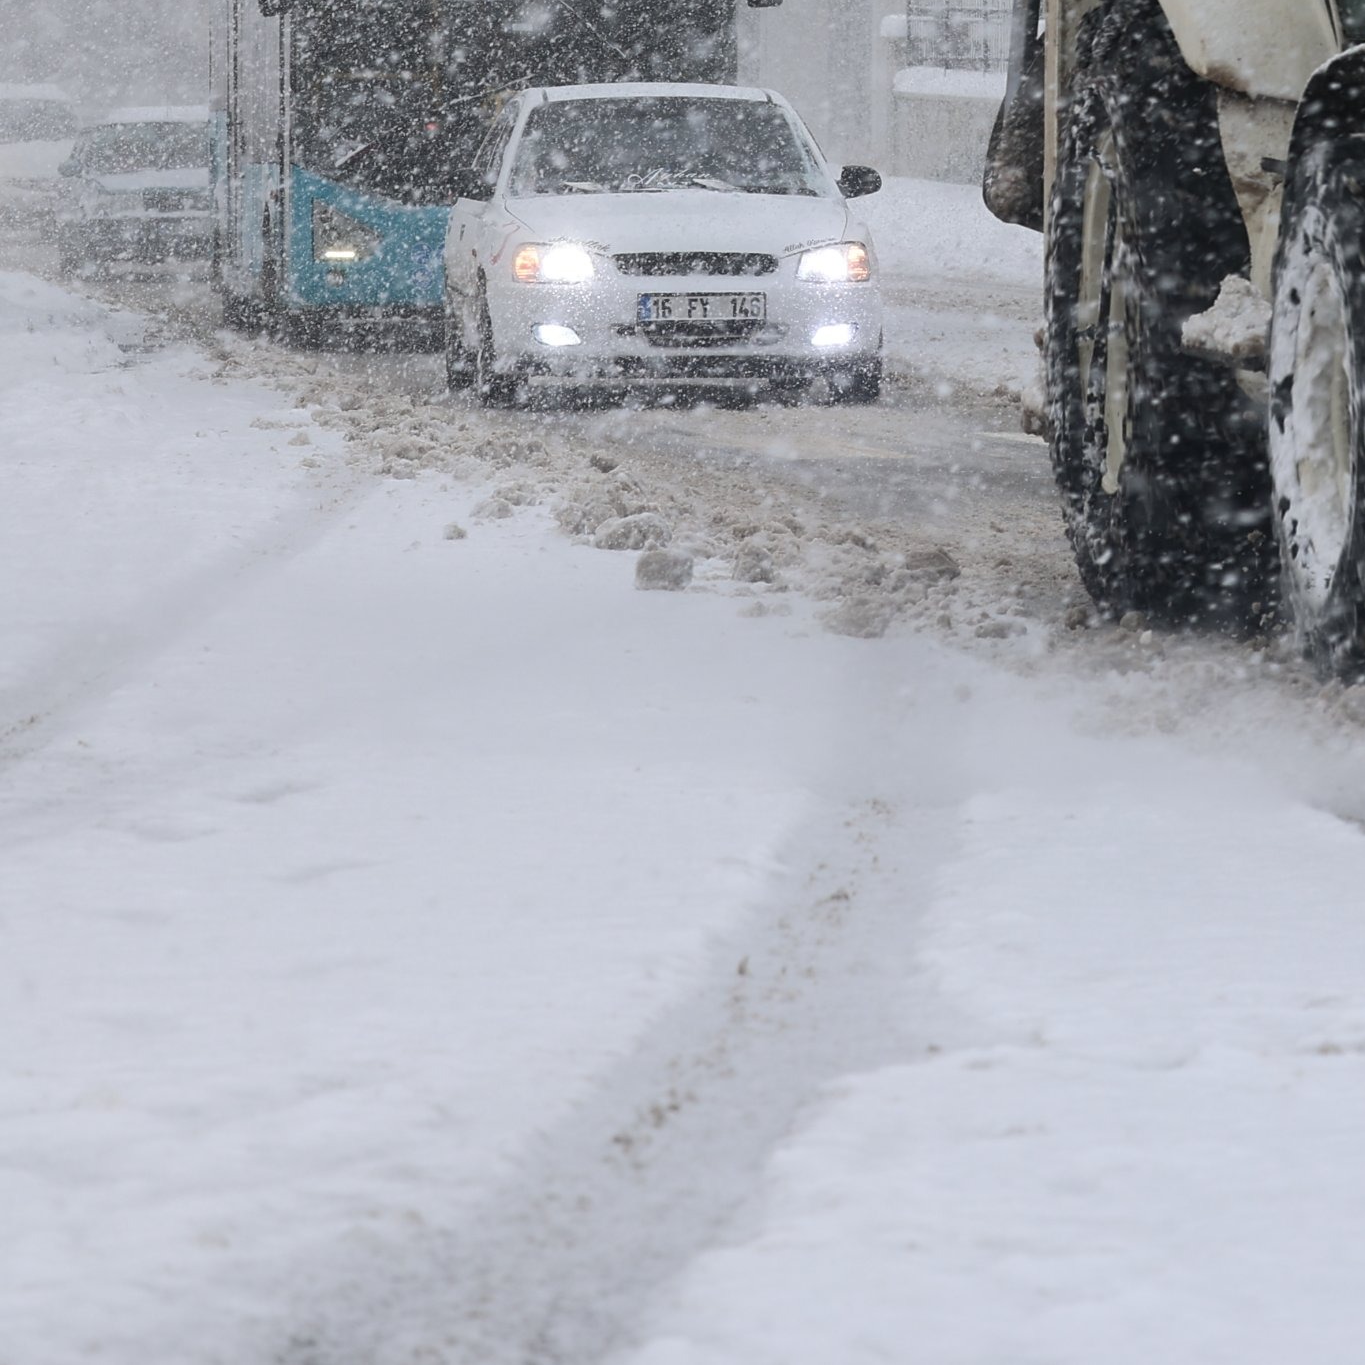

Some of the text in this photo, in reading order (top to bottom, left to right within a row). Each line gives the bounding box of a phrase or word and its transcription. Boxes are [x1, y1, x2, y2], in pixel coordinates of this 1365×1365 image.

[652, 296, 760, 319] 16 FY 146
